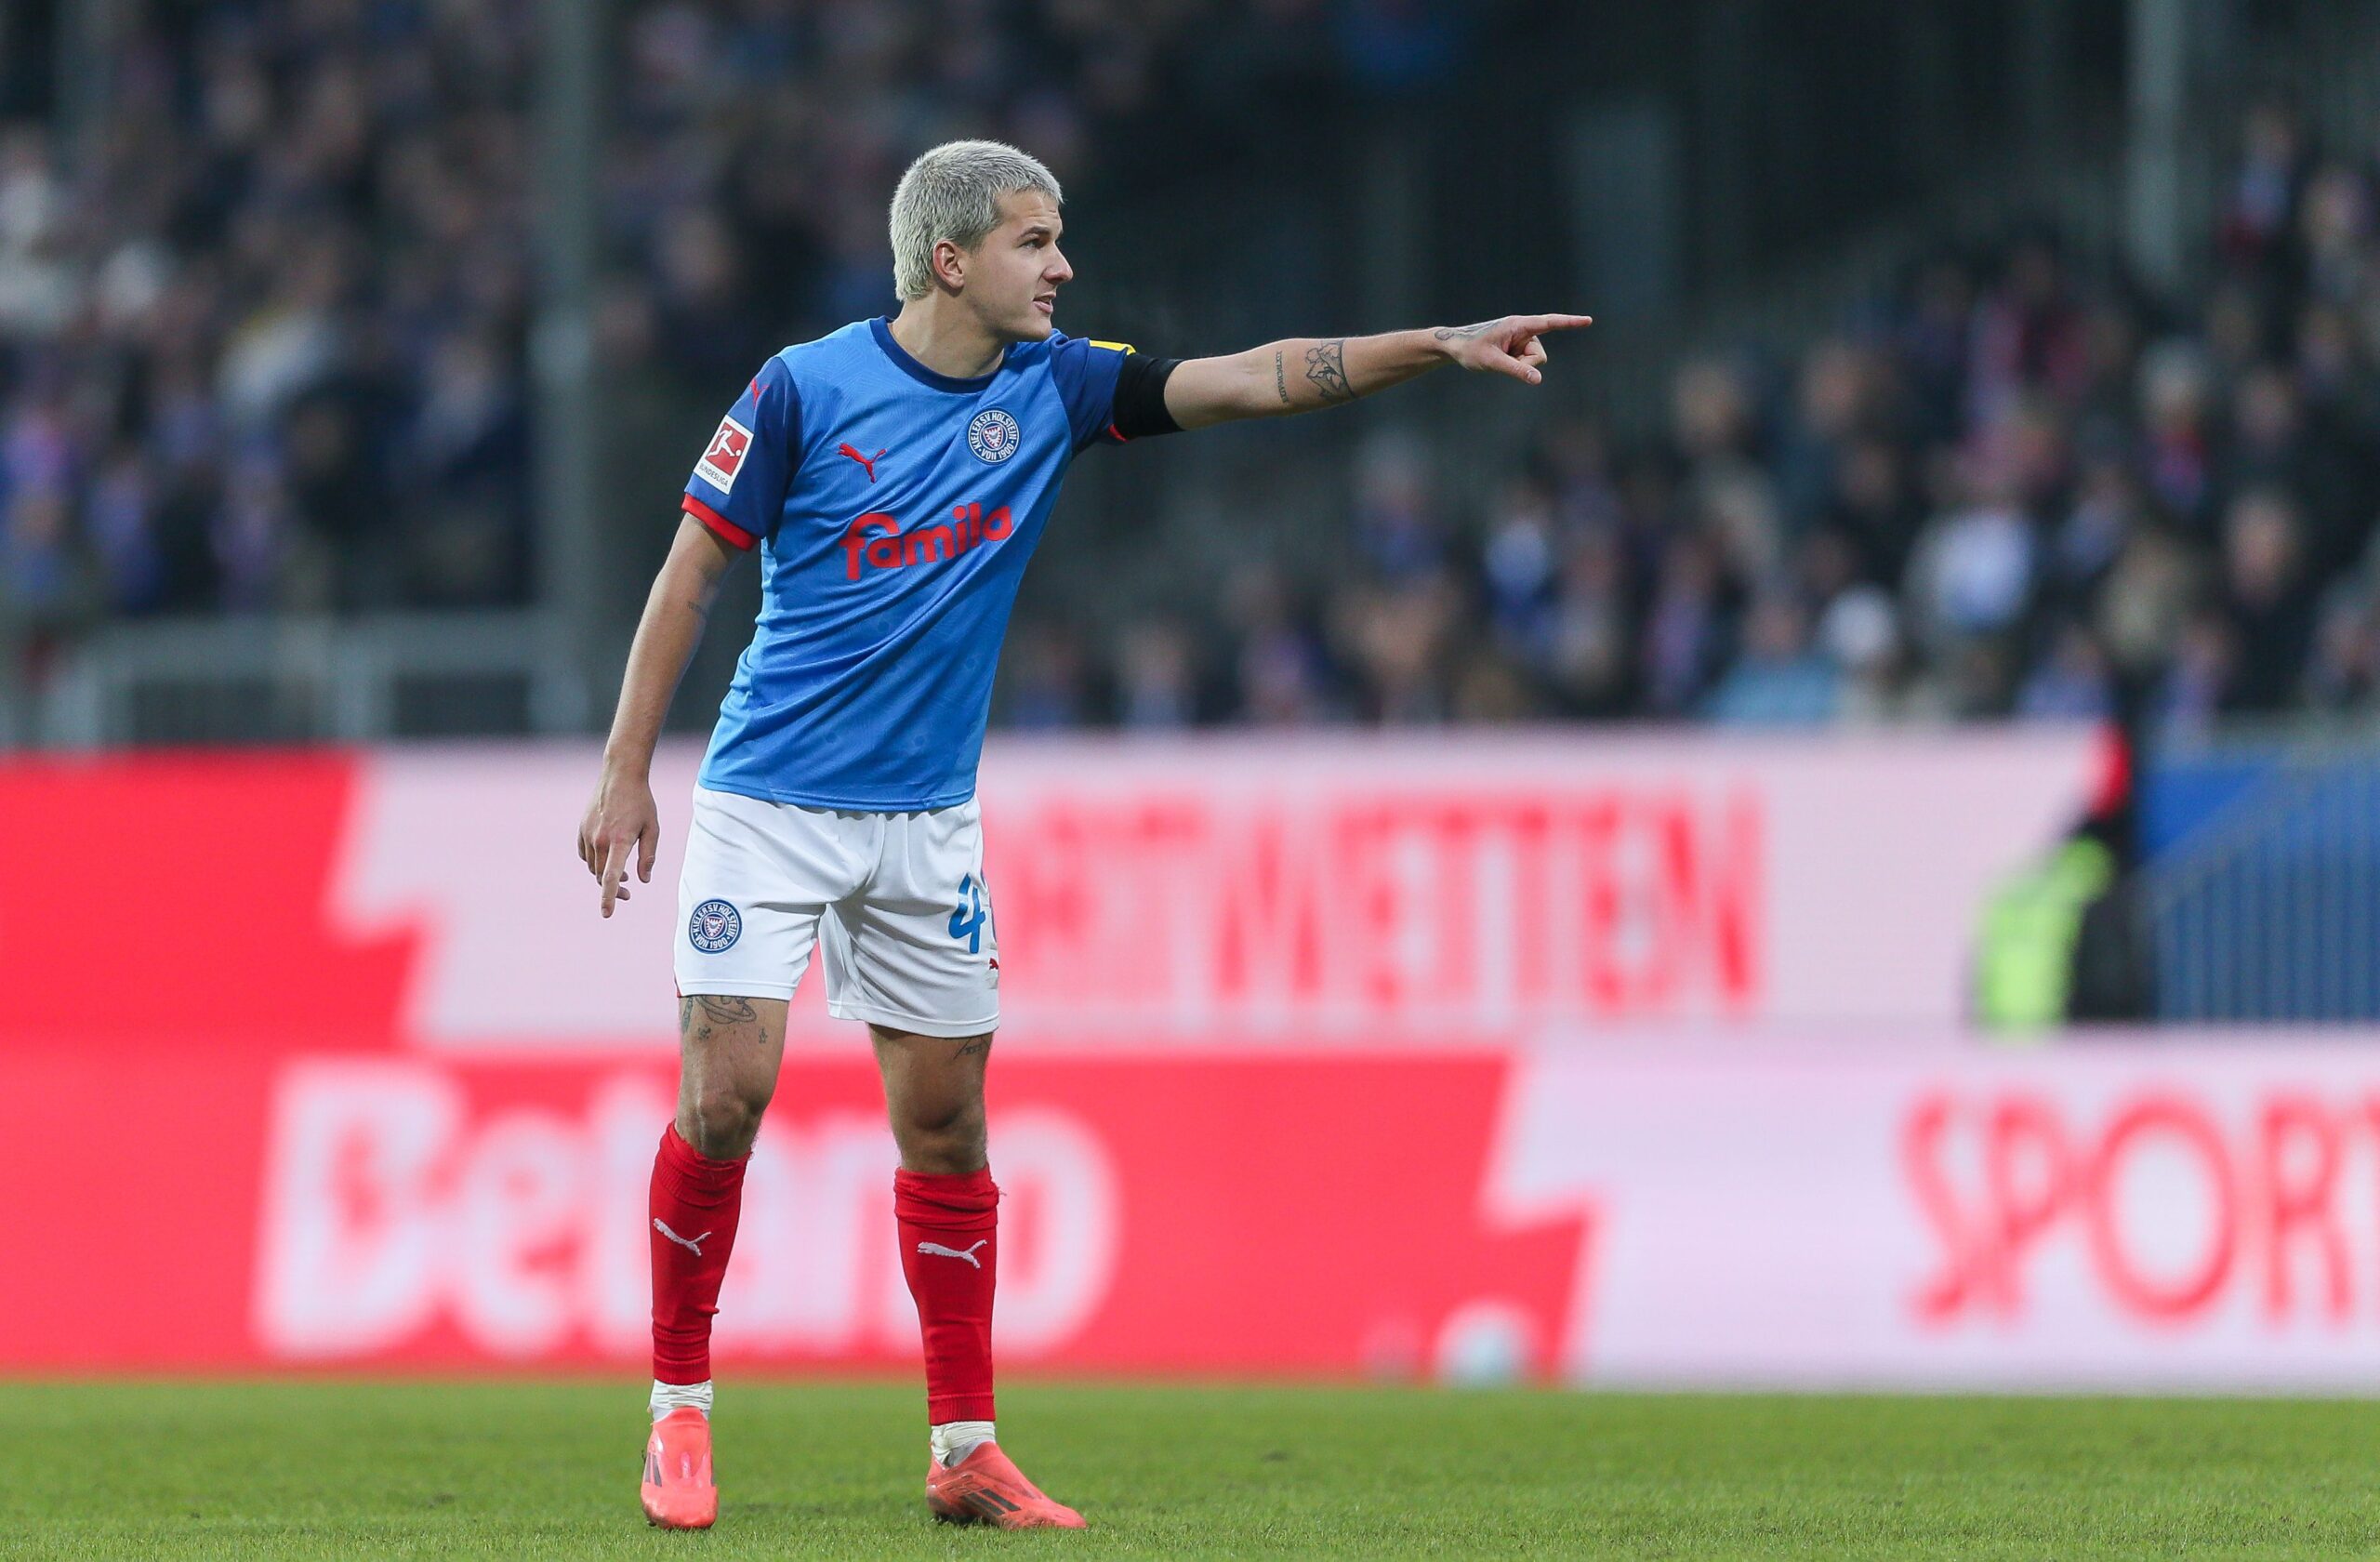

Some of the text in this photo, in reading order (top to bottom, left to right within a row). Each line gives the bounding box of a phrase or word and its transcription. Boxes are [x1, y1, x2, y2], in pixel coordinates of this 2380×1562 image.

[971, 412, 1017, 449] KIELER SV HOLSTEIN
[998, 443, 1014, 459] 1900
[839, 502, 1013, 581] famila
[692, 904, 737, 938] KIELER SV HOLSTEIN
[709, 937, 728, 948] 1900
[1898, 1090, 2380, 1328] SPOR
